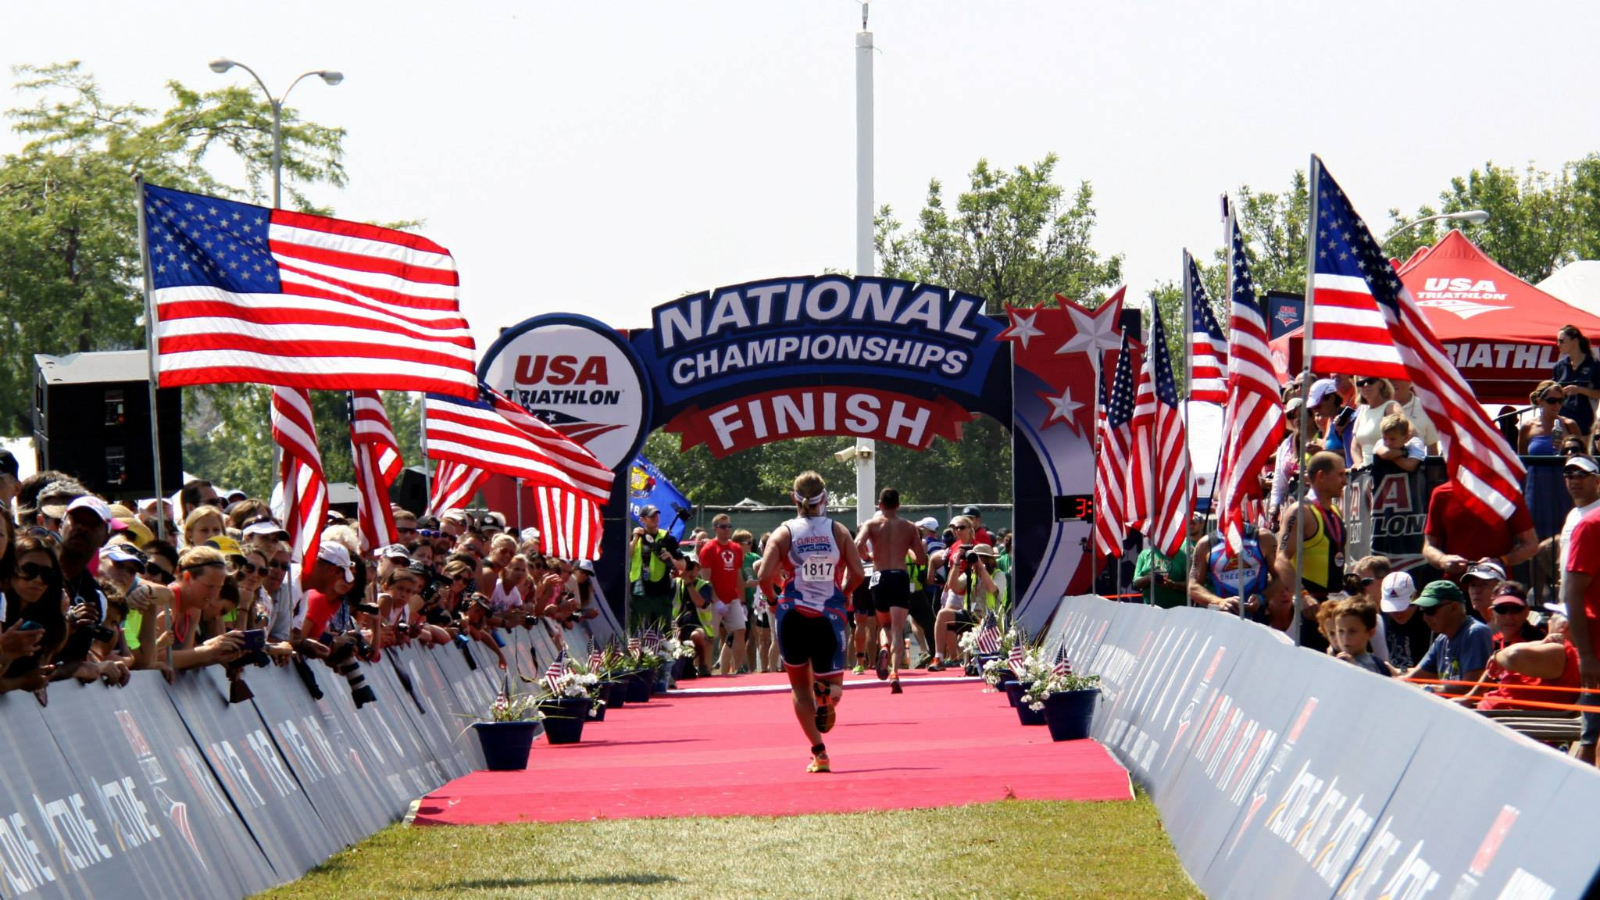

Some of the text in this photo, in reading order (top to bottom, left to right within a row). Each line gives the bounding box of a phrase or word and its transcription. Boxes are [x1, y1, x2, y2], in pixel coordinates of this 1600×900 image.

[1424, 278, 1496, 292] USA
[1416, 292, 1508, 300] TRIATHLON
[659, 281, 978, 349] NATIONAL
[672, 335, 968, 384] CHAMPIONSHIPS
[514, 355, 608, 385] USA
[504, 389, 620, 405] TRIATHLON
[708, 392, 931, 449] FINISH
[797, 535, 831, 545] CURBSIDE
[803, 563, 832, 576] 1817
